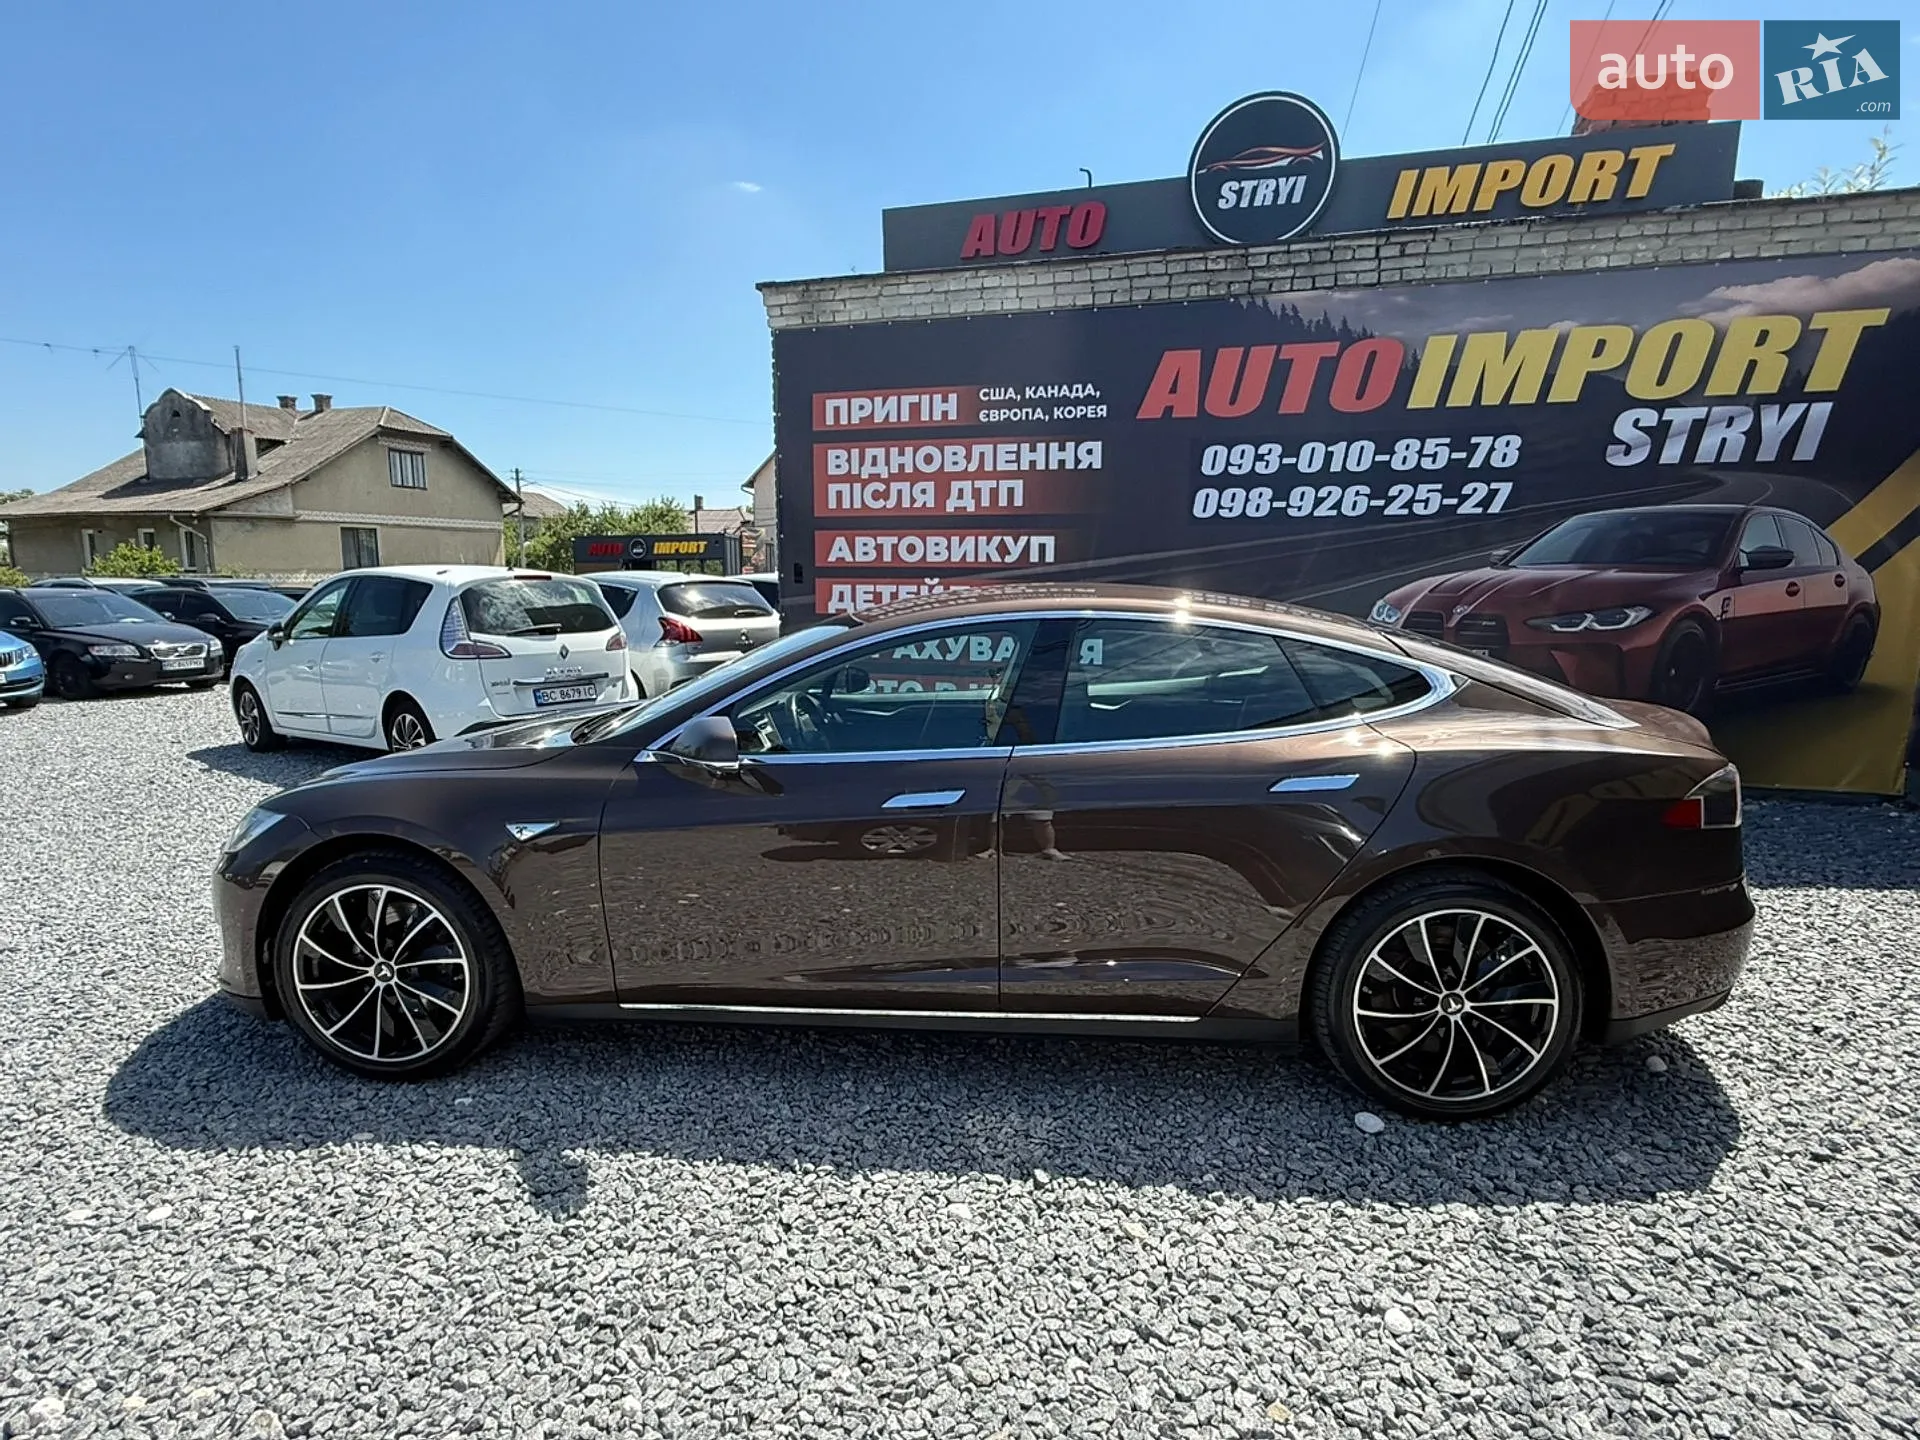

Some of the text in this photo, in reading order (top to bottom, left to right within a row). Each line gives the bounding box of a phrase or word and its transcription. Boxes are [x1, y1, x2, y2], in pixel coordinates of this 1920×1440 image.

[960, 144, 1675, 259] AUTO STRYI IMPORT
[1137, 308, 1890, 420] AUTO IMPORT
[979, 383, 1100, 401] США, КАНАДА,
[825, 393, 958, 425] ПРИГІН
[979, 405, 1107, 422] ЄВРОПА, КОРЕЯ
[1605, 402, 1834, 467] STRYI
[827, 441, 1102, 478] ВІДНОВЛЕННЯ
[1201, 435, 1522, 476] 093-010-85-78
[827, 479, 1023, 512] ПІСЛЯ ДТП
[1193, 482, 1513, 518] 098-926-25-27
[588, 541, 707, 556] AUTO IMPORT
[827, 535, 1055, 562] АВТОВИКУП
[540, 690, 556, 703] BC
[558, 687, 581, 699] 8679
